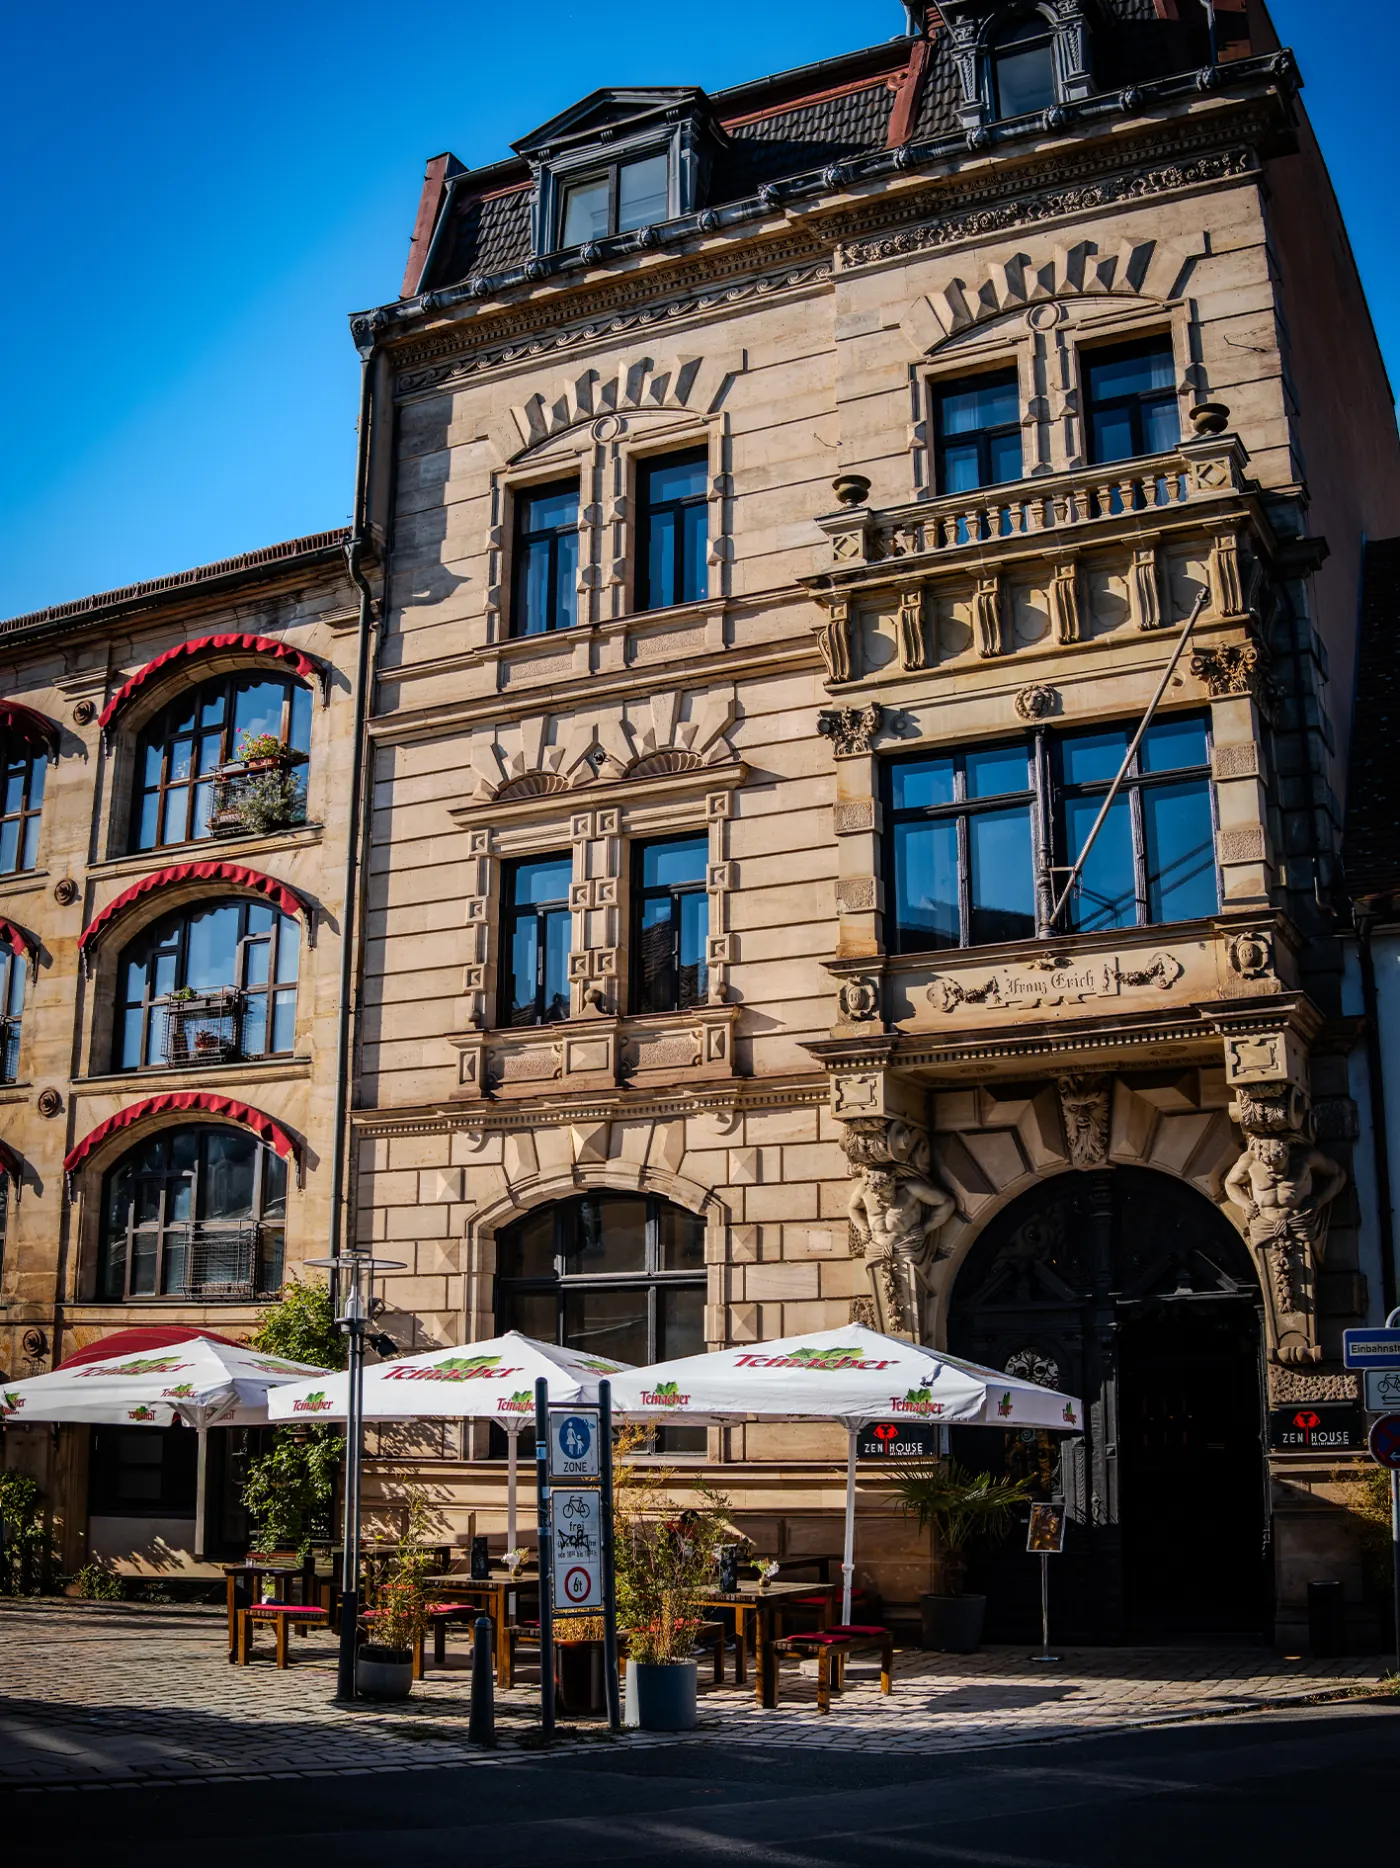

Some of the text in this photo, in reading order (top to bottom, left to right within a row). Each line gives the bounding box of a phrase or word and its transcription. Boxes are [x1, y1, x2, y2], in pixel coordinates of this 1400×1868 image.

[1005, 969, 1096, 996] Franz Erich
[733, 1353, 901, 1371] Teinacher
[381, 1364, 525, 1381] Teinacher
[292, 1399, 334, 1412] Teinacher
[496, 1397, 536, 1412] Teinache
[640, 1390, 691, 1406] Teinacher
[888, 1396, 945, 1415] Teinacher
[1282, 1431, 1349, 1443] ZEN HOUSE
[864, 1442, 923, 1453] ZEN HOUSE
[563, 1461, 587, 1473] ZONE
[569, 1521, 585, 1532] frei
[573, 1577, 582, 1593] 6t
